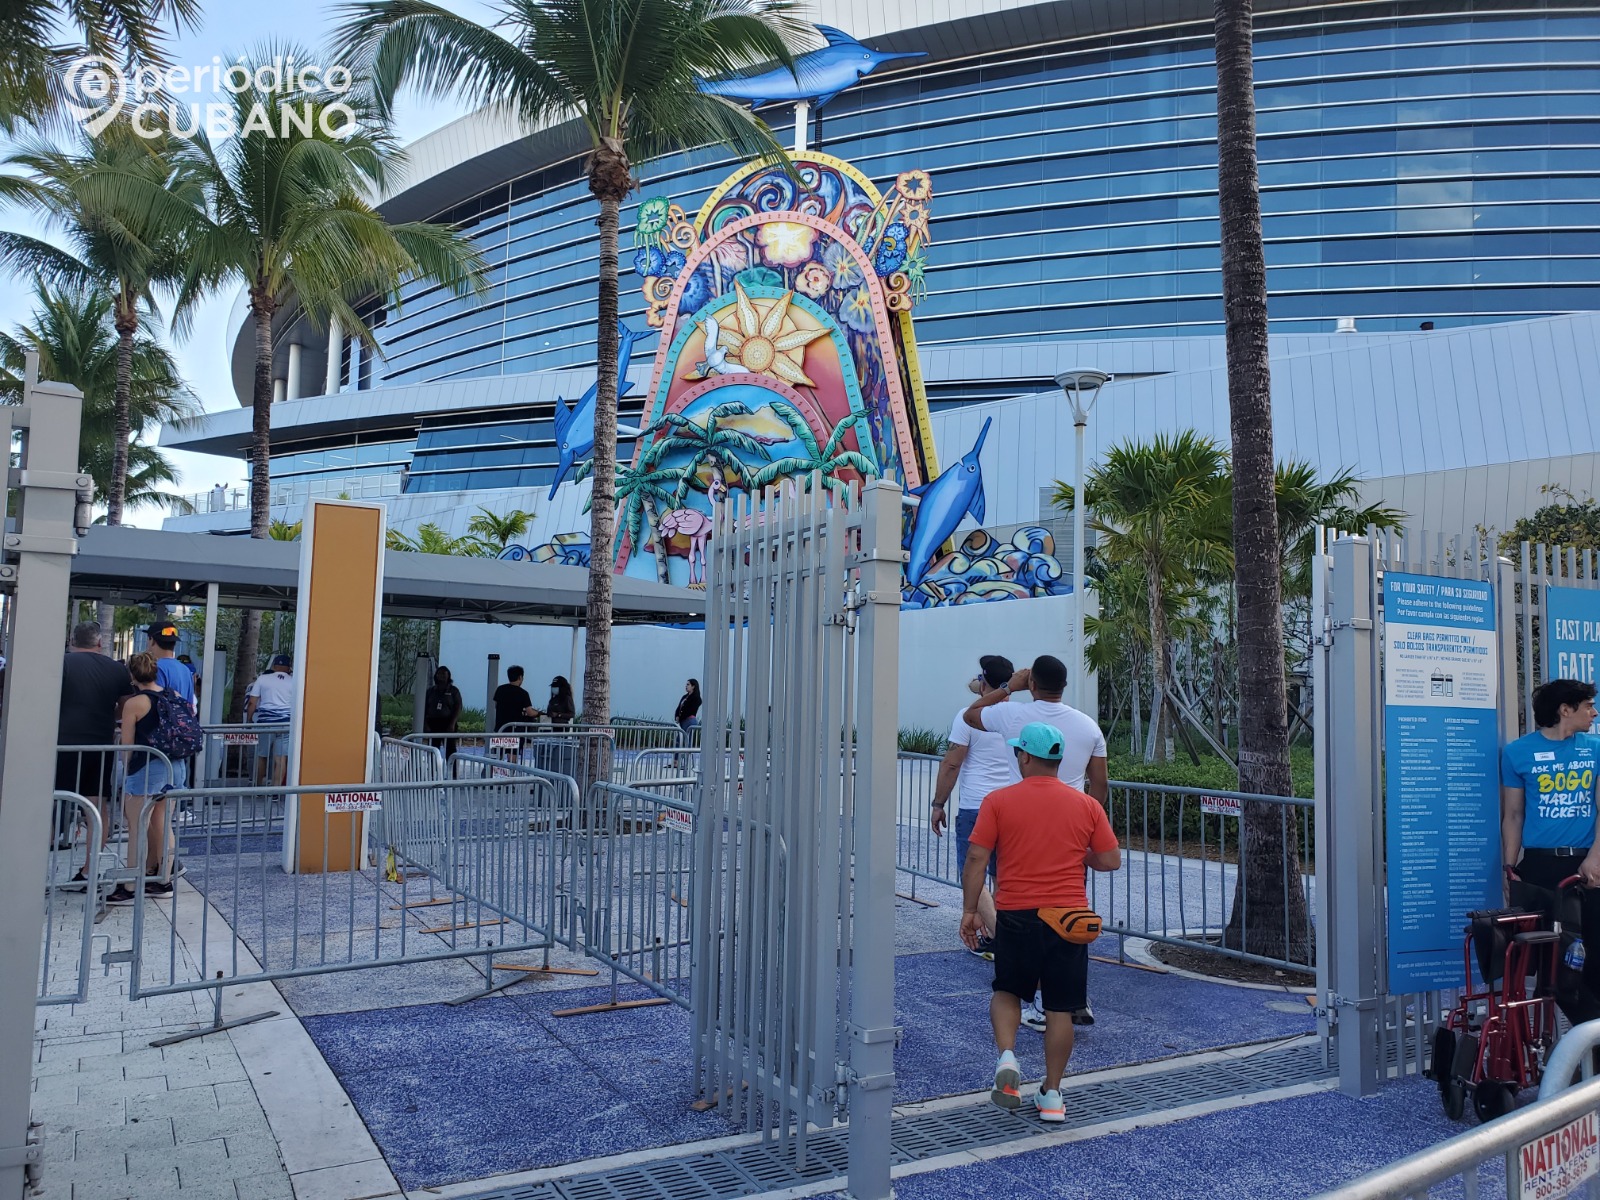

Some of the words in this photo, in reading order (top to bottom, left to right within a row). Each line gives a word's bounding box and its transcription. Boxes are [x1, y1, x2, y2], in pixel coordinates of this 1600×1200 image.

[1390, 581, 1401, 592] FOR
[1402, 582, 1416, 594] YOUR
[1417, 584, 1435, 595] SAFETY
[1441, 586, 1454, 597] PARA
[1463, 588, 1488, 601] SEGURIDAD
[1397, 597, 1413, 606] Please
[1413, 598, 1428, 607] adhere
[1429, 599, 1434, 607] to
[1434, 600, 1442, 608] the
[1442, 601, 1462, 611] following
[1463, 603, 1484, 613] guidelines
[1397, 608, 1405, 616] Por
[1405, 609, 1418, 617] favor
[1418, 610, 1434, 619] cumpla
[1450, 613, 1471, 622] siguientes
[1472, 615, 1484, 623] reglas
[1407, 631, 1422, 641] CLEAR
[1422, 632, 1435, 641] BAGS
[1436, 633, 1460, 643] PERMITTED
[1460, 635, 1471, 644] ONLY
[1555, 618, 1580, 641] EAST
[1393, 641, 1406, 650] SOLO
[1406, 641, 1425, 651] BOLSOS
[1425, 643, 1463, 654] TRANSPARENTES
[1463, 645, 1488, 656] PERMITIDOS
[1558, 651, 1594, 685] GATE
[491, 737, 519, 745] NATIONAL
[1531, 765, 1550, 774] ASK
[1552, 763, 1565, 772] ME
[1567, 760, 1595, 770] ABOUT
[1537, 769, 1593, 793] BOGO
[328, 792, 380, 804] NATIONAL
[1202, 796, 1241, 808] NATIONAL
[1539, 789, 1591, 806] MARLINS
[666, 807, 692, 825] NATIONAL
[1537, 804, 1591, 819] TICKETS!
[1523, 1114, 1597, 1181] NATIONAL
[1524, 1144, 1598, 1194] RENT-A-FENCE
